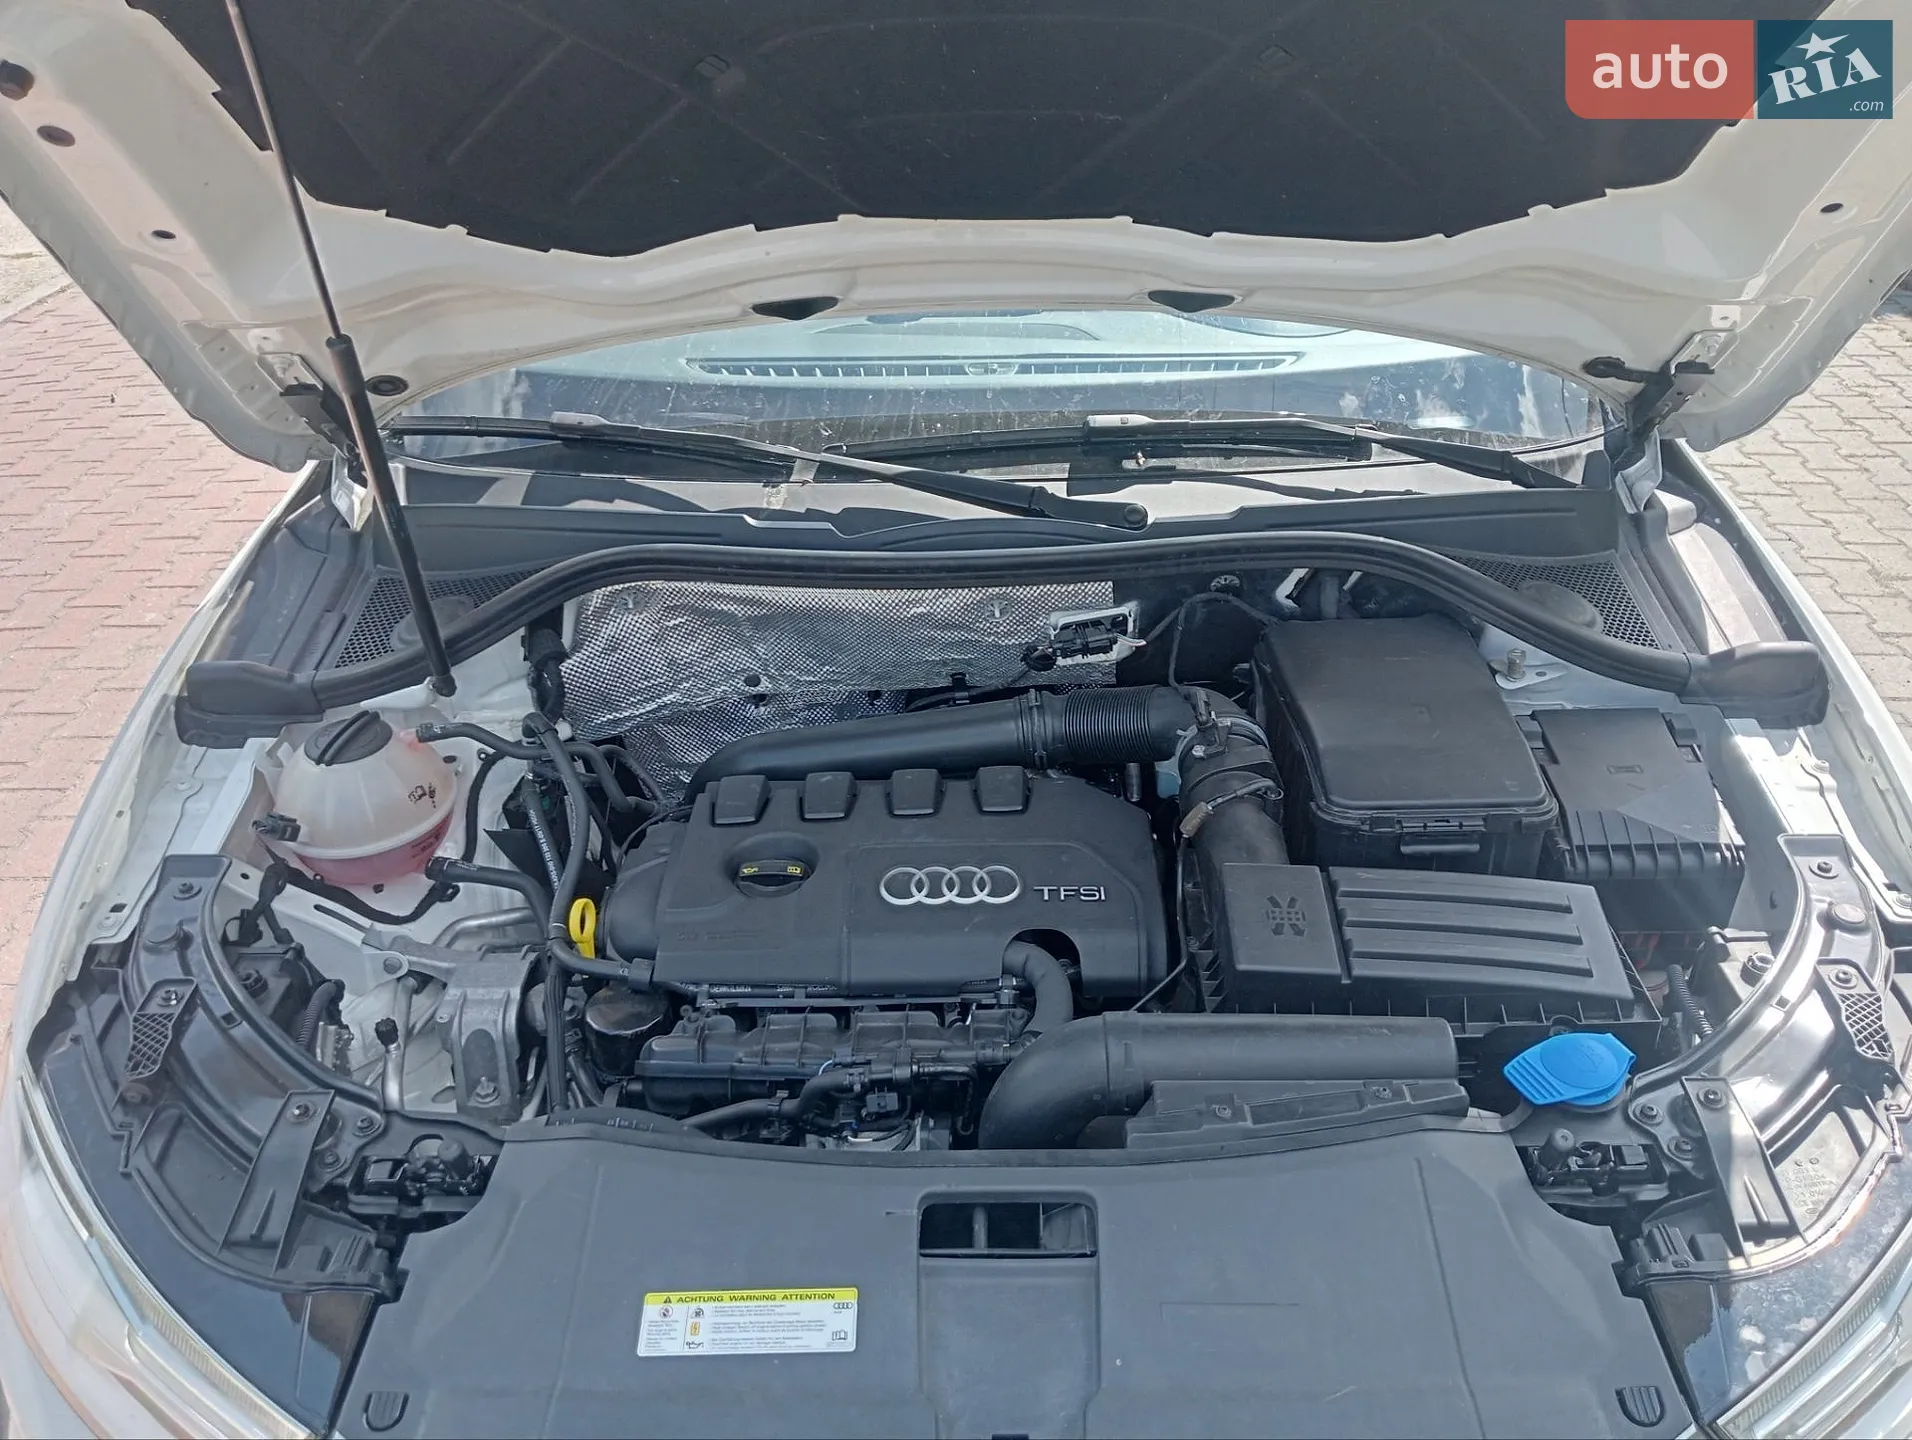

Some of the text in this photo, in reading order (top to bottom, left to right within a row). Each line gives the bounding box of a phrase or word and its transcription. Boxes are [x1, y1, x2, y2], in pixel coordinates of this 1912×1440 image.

[1033, 886, 1106, 901] TFSI
[676, 1292, 836, 1303] ACHTUNG WARNING ATTENTION
